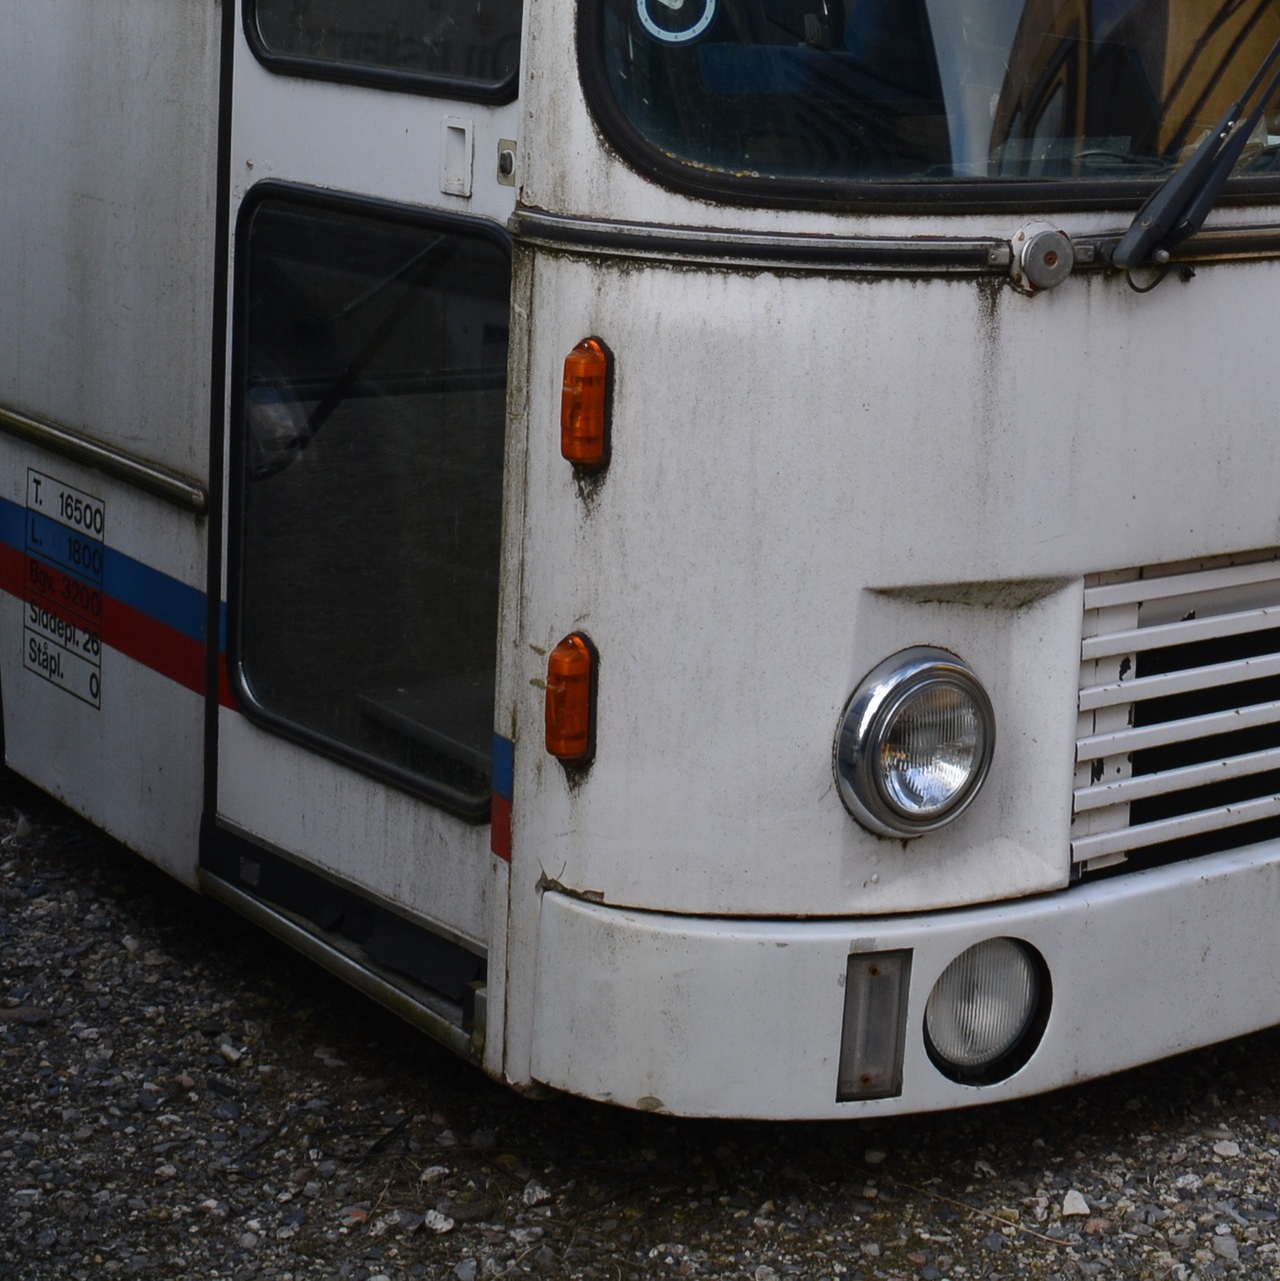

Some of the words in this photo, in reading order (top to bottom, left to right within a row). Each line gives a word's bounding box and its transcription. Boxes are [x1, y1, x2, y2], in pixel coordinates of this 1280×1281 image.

[32, 477, 43, 506] T.
[59, 491, 103, 535] 16500
[31, 517, 43, 546] L.
[68, 537, 102, 575] 1800
[30, 559, 55, 595] Bgv.
[61, 576, 100, 617] 3200
[29, 599, 79, 647] Siddepl.
[82, 630, 100, 656] 26
[28, 638, 64, 679] Ståpl.
[89, 671, 100, 699] 0
